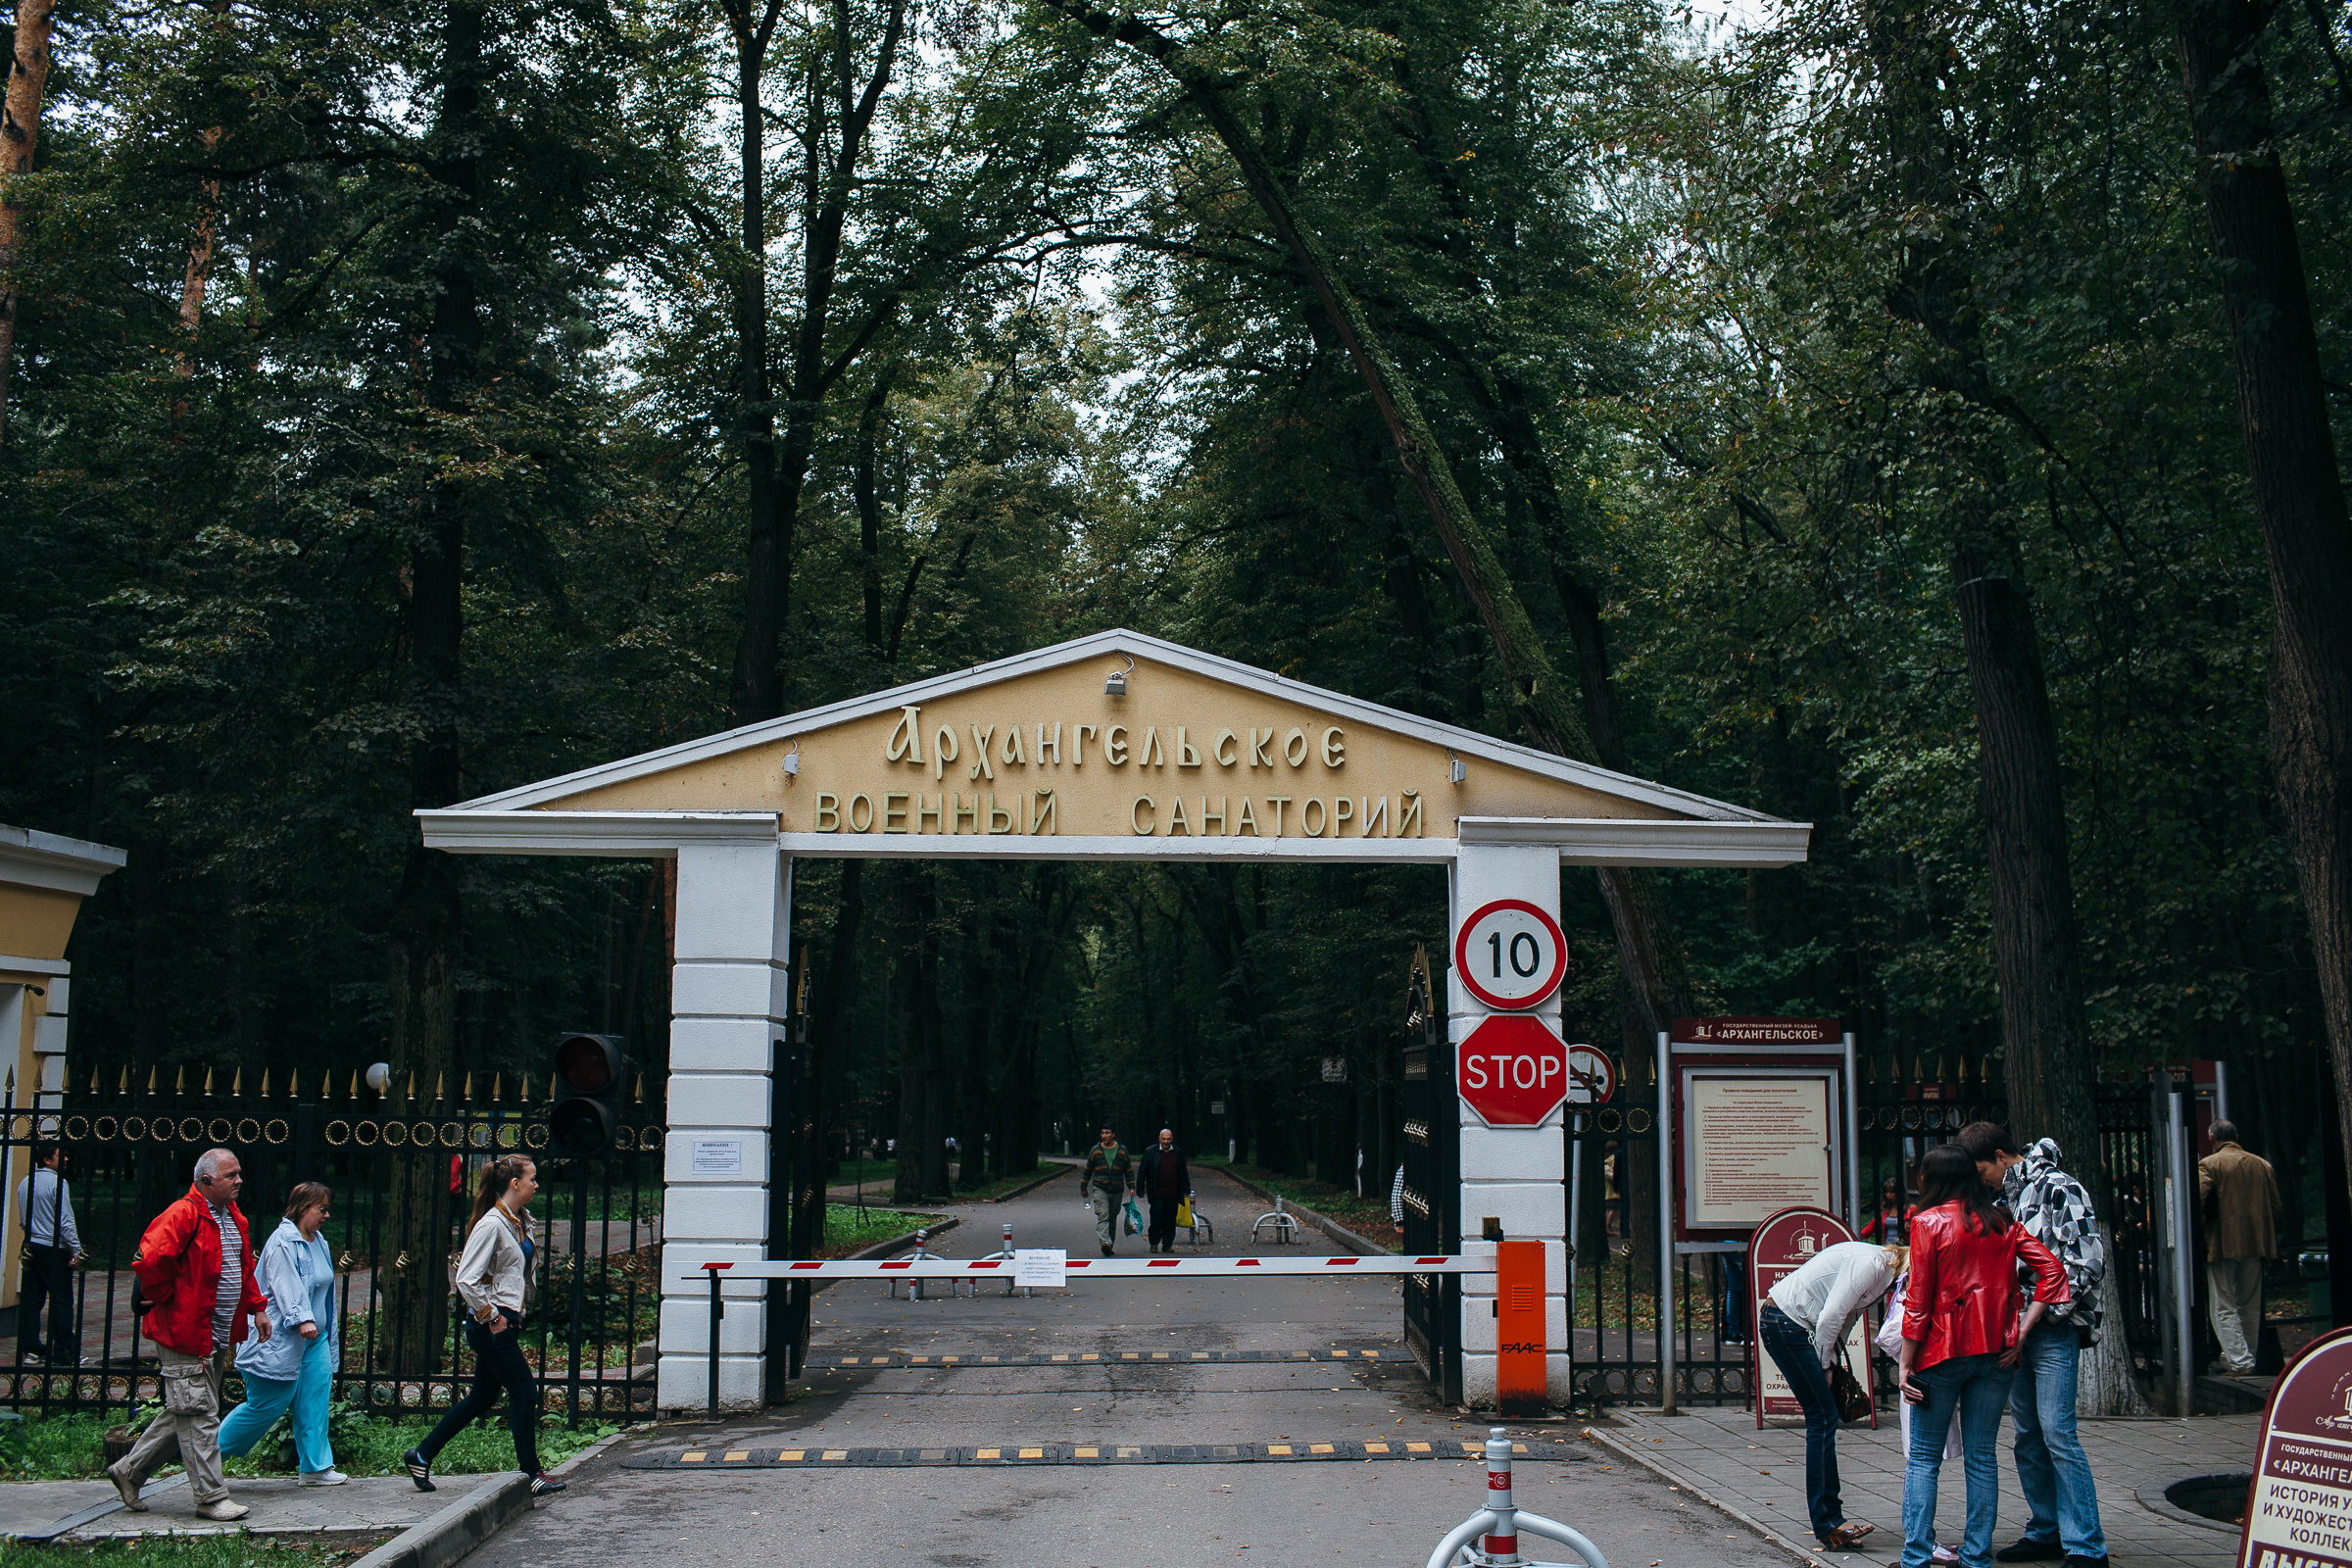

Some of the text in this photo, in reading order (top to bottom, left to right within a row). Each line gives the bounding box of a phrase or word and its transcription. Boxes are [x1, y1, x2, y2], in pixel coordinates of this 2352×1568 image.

[814, 788, 1423, 838] ВОЕННЫЙ САНАТОРИЙ
[1487, 931, 1541, 979] 10
[1716, 1029, 1824, 1040] «АРХАНГЕЛЬСКОЕ»
[1466, 1054, 1560, 1090] STOP
[1501, 1343, 1543, 1353] FAAC
[2263, 1502, 2274, 1516] И
[2270, 1484, 2339, 1509] ИСТОРИЯ
[2289, 1527, 2352, 1552] КОЛЛЕК
